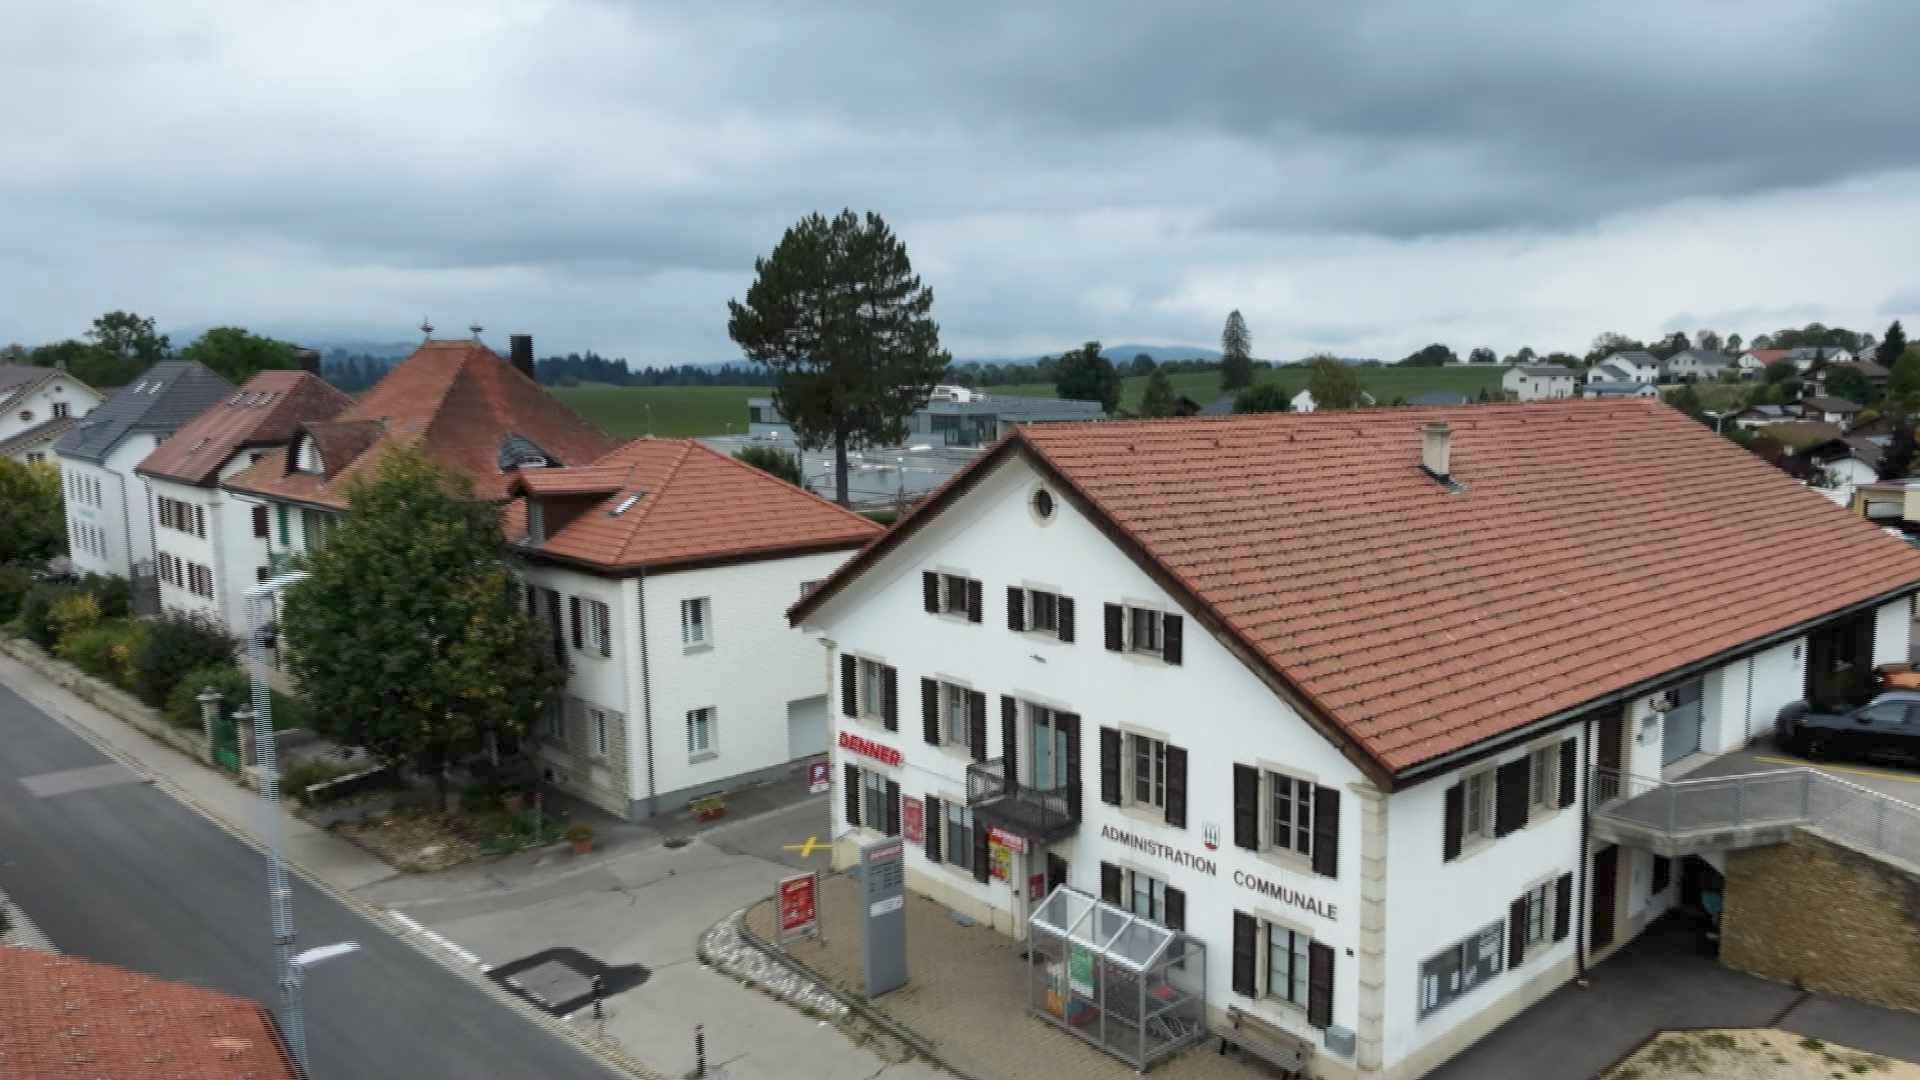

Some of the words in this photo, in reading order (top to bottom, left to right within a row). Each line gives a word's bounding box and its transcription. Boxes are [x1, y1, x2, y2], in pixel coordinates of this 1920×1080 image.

[840, 730, 903, 768] DENNER
[1101, 824, 1217, 876] ADMINISTRATION
[1233, 870, 1337, 920] COMMUNALE
